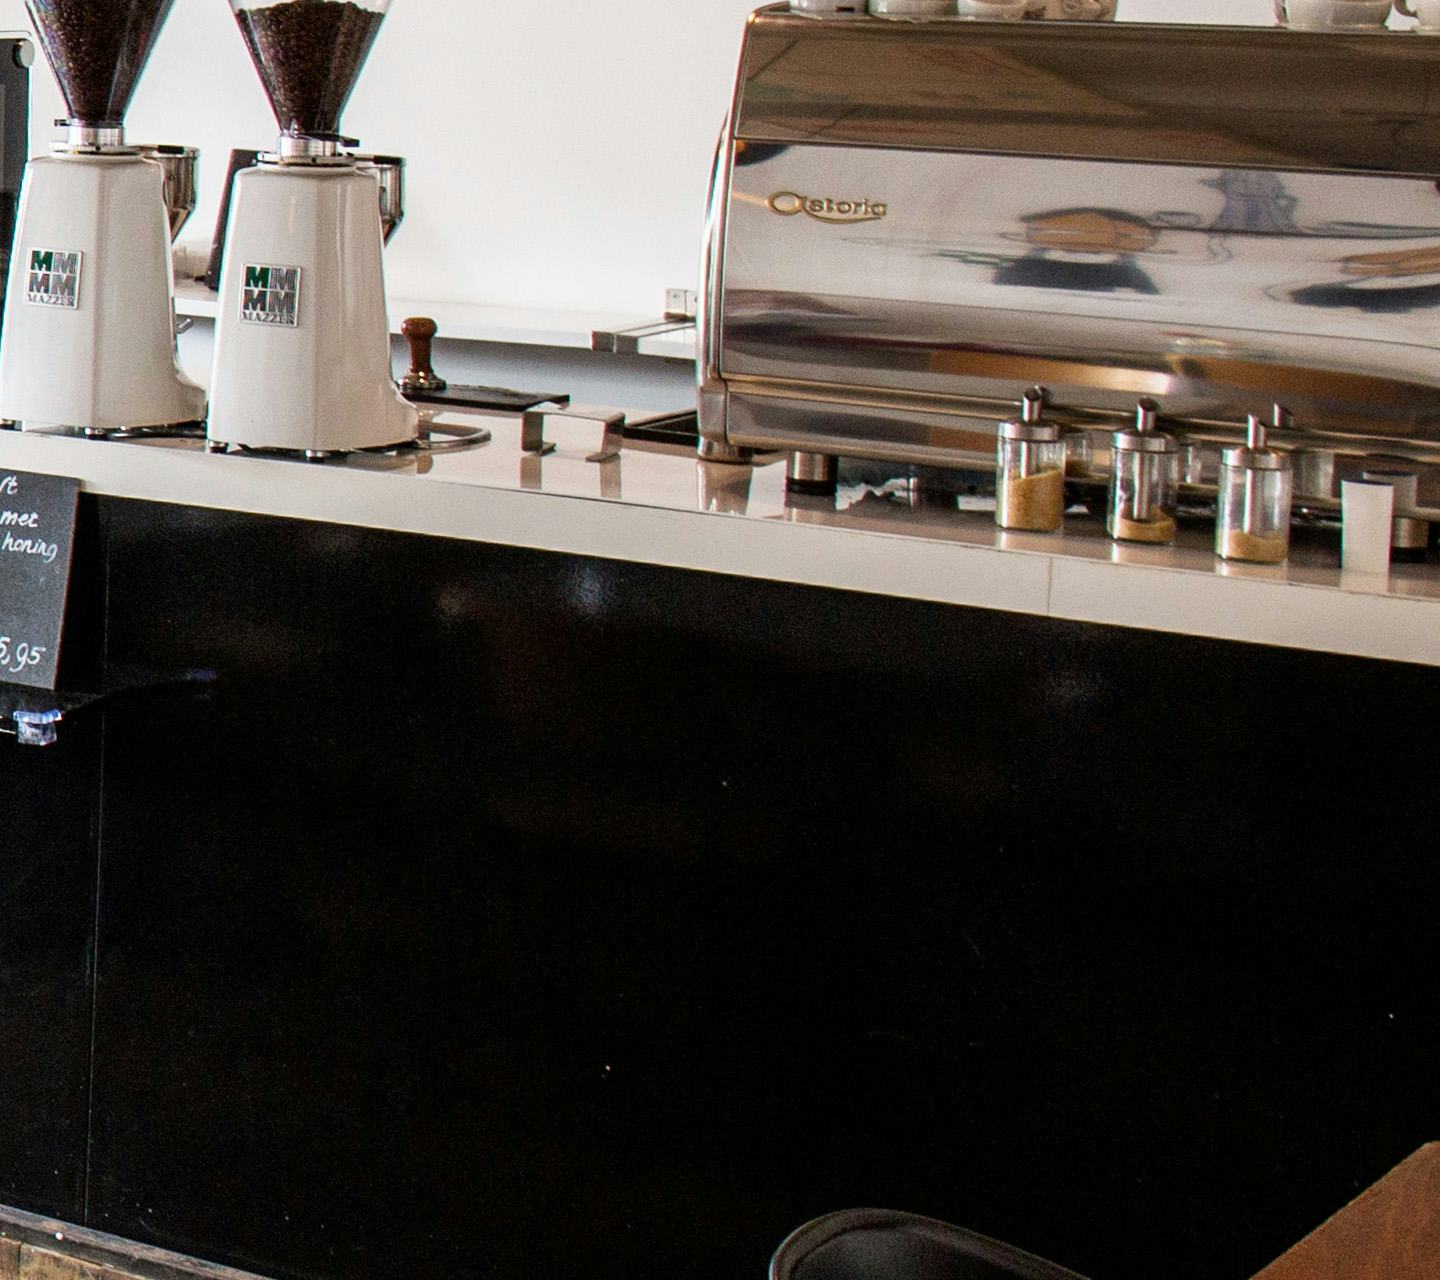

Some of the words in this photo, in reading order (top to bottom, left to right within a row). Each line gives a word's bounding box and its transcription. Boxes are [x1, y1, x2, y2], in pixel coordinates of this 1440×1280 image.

[27, 293, 76, 307] MAZZER
[241, 310, 295, 325] MAZZER
[0, 509, 38, 528] met
[1, 531, 58, 562] honing
